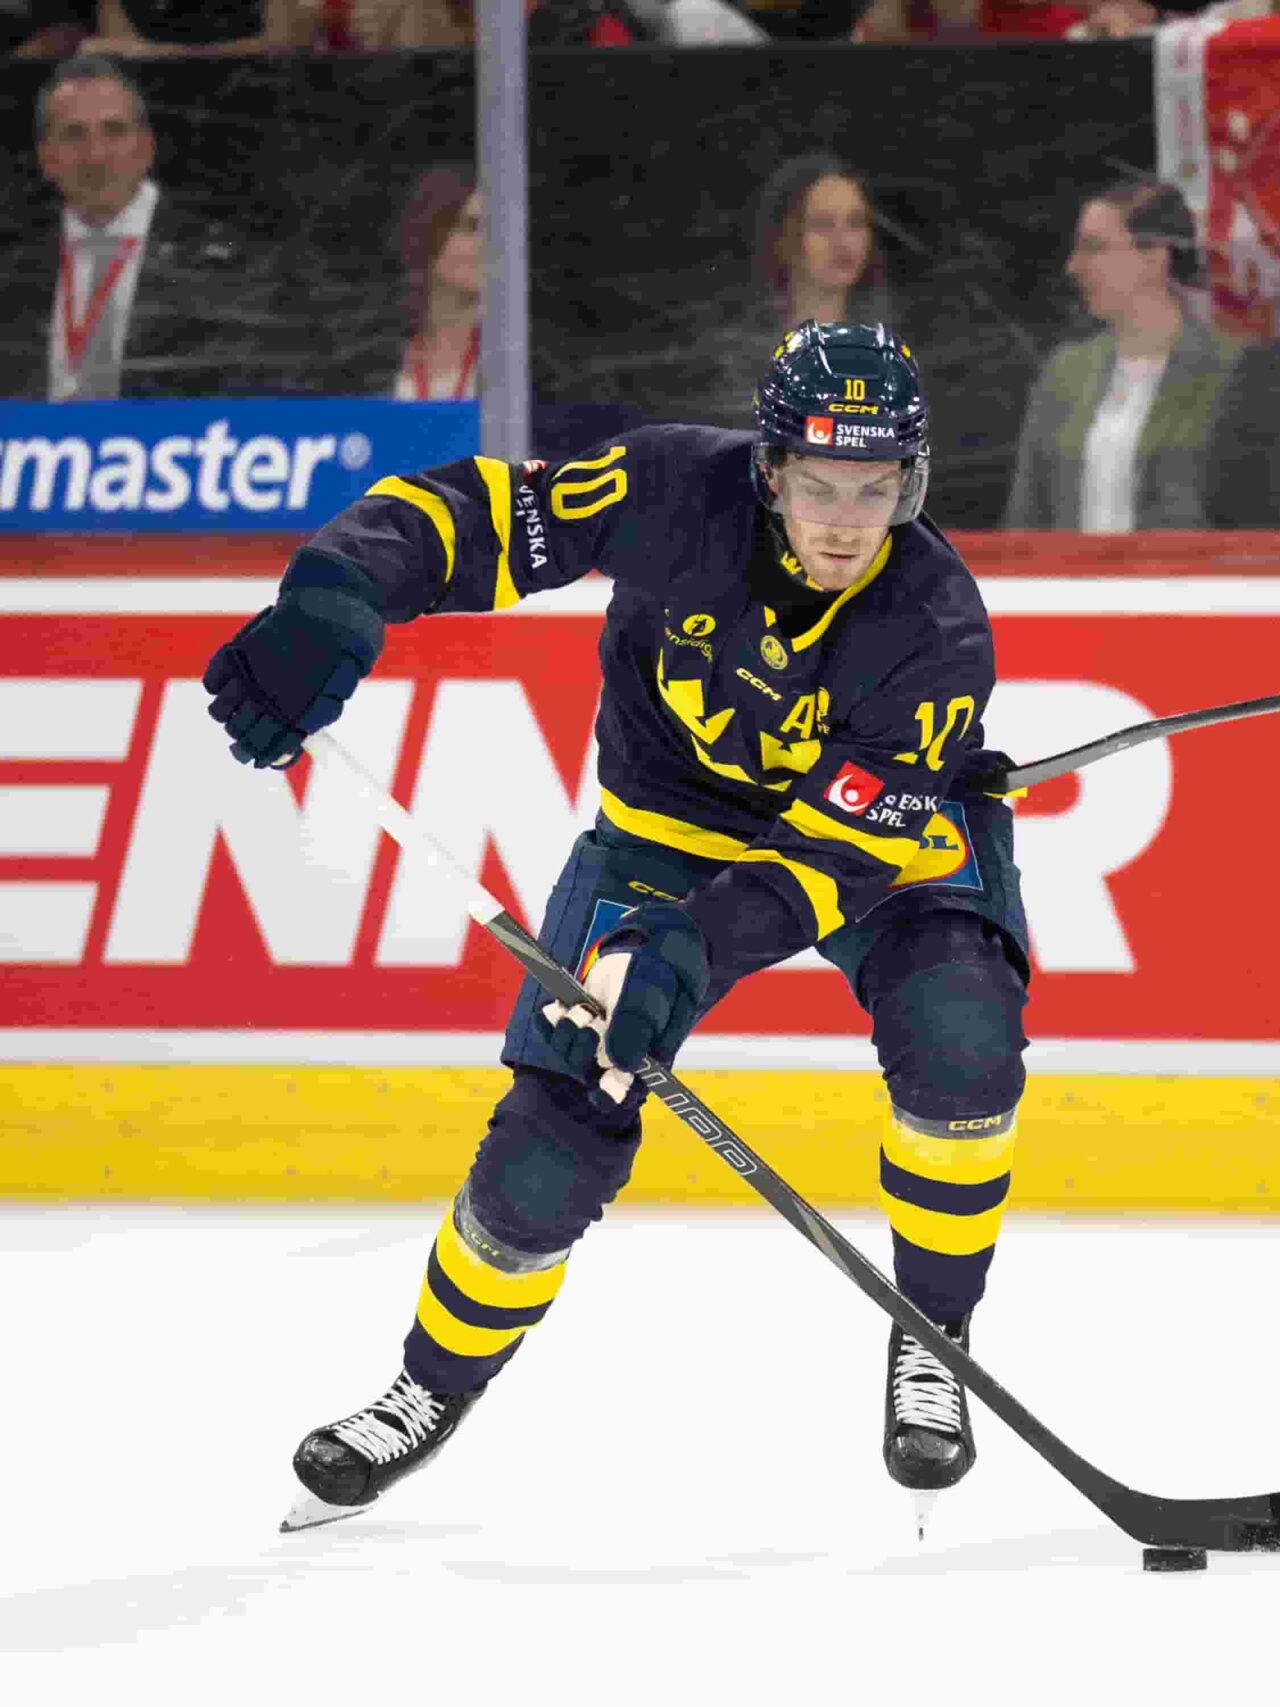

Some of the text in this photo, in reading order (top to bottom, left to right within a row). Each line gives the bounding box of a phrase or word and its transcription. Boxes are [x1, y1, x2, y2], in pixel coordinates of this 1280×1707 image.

[844, 379, 866, 401] 10
[828, 402, 880, 415] CCM
[836, 423, 895, 438] SVENSKA
[835, 435, 867, 448] SPEL
[550, 446, 627, 520] 10
[735, 667, 783, 701] CCM
[0, 677, 1172, 974] ENNR
[866, 808, 907, 828] SPEL
[947, 1115, 1002, 1131] CCM
